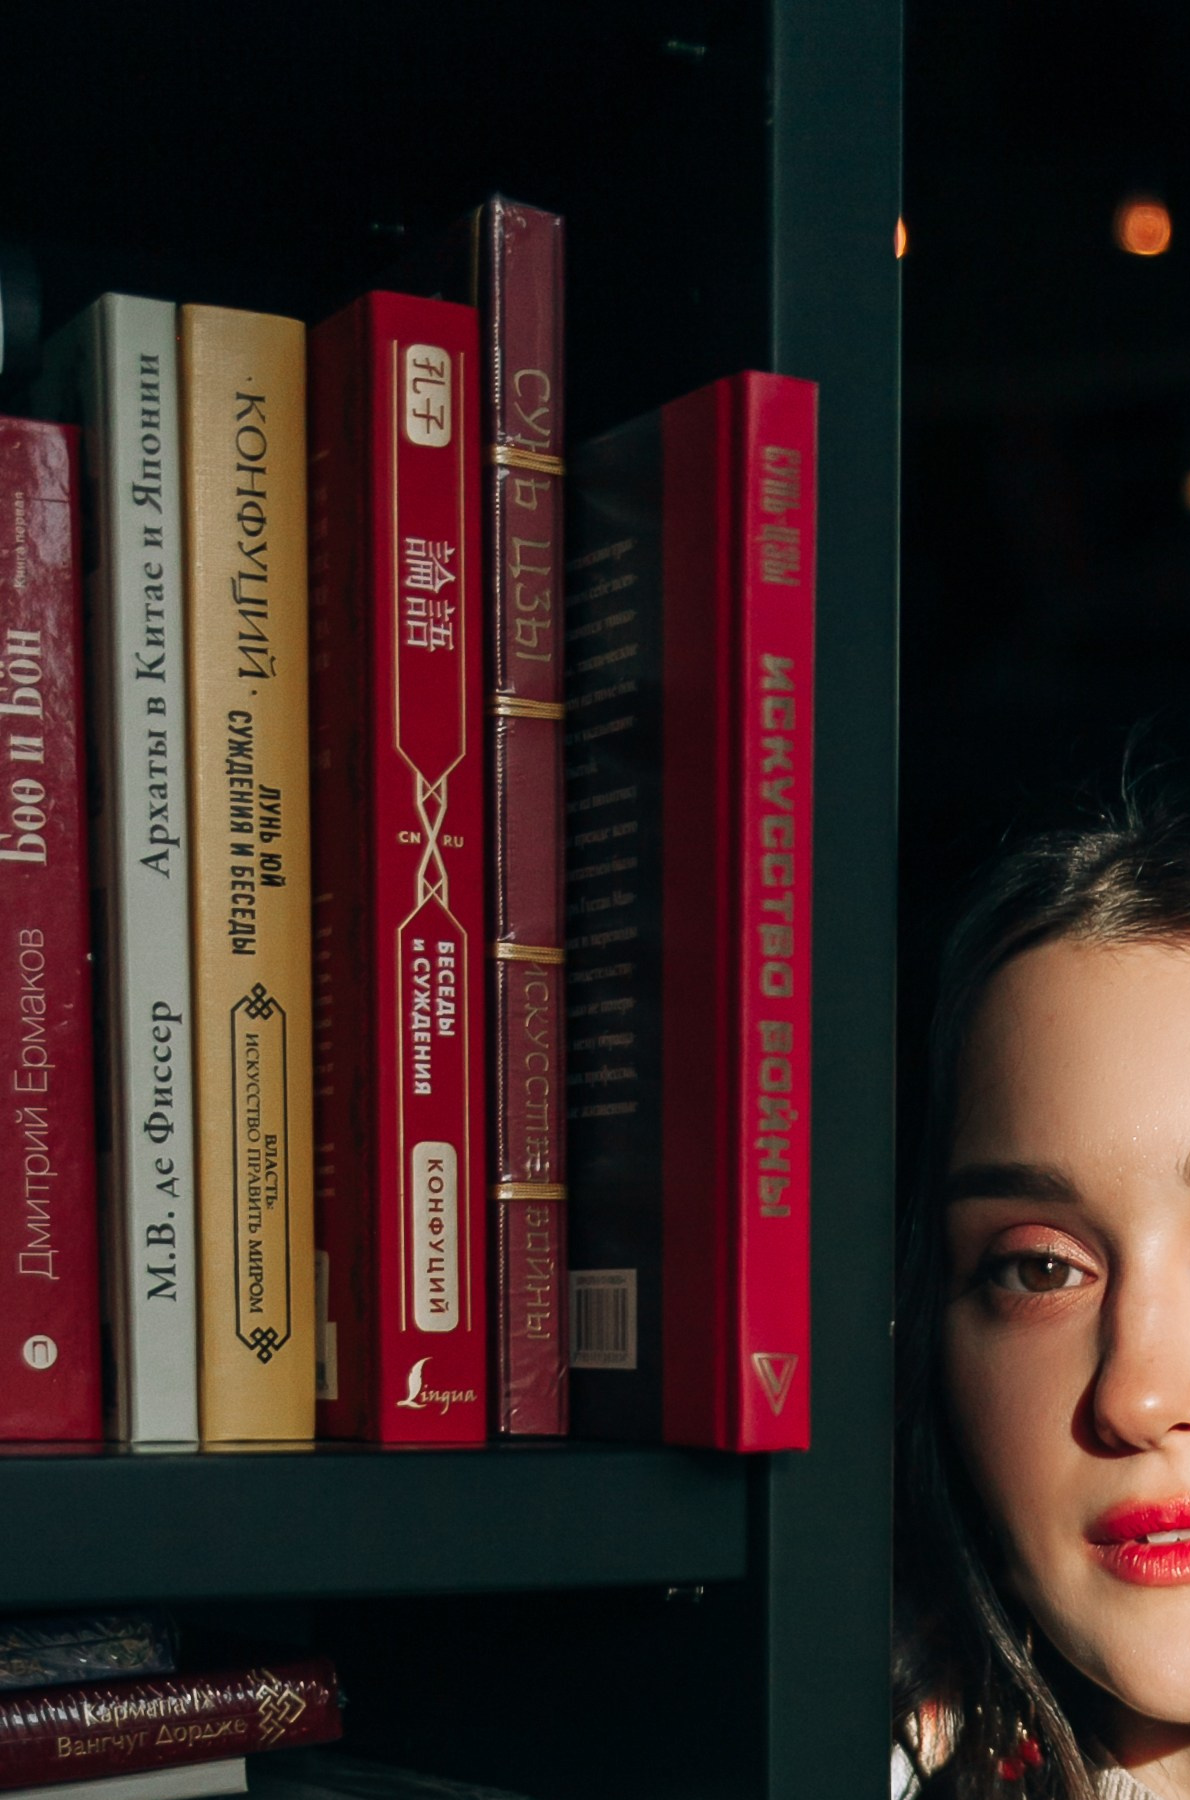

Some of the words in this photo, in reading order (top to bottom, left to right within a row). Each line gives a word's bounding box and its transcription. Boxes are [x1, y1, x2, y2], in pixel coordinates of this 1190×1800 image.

[132, 353, 163, 515] Японии
[411, 355, 445, 435] 孔子
[144, 527, 163, 549] и
[230, 391, 277, 680] КОНФУЦИЙ
[760, 445, 801, 587] СУНЬ-ЦЗЫ
[135, 562, 167, 683] Китае
[404, 537, 455, 653] 論語
[509, 540, 552, 663] ЦЗЫ
[9, 737, 45, 764] и
[148, 696, 166, 717] в
[140, 727, 180, 880] Архаты
[226, 710, 255, 834] СУЖДЕНИЯ
[259, 784, 282, 843] ЛУНЬ
[230, 843, 255, 857] И
[260, 848, 287, 888] ЮЙ
[398, 830, 421, 846] CN
[443, 833, 465, 849] RU
[758, 654, 796, 999] ИСКУССТВО
[227, 864, 257, 956] БЕСЕДЫ
[413, 938, 426, 952] и
[15, 928, 56, 1094] Ермаков
[411, 957, 432, 1095] СУЖДЕНИЯ
[436, 941, 456, 1037] БЕСЕДЫ
[145, 1001, 184, 1146] Фиссер
[244, 1033, 262, 1143] ИСКУССТВО
[755, 1020, 798, 1218] ВОЙНЫ
[15, 1107, 60, 1281] Дмитрий
[153, 1157, 181, 1199] де
[247, 1148, 263, 1234] ПРАВИТЬ
[264, 1133, 280, 1210] ВЛАСТЬ:
[146, 1211, 177, 1303] М.В.
[248, 1240, 264, 1314] МИРОМ
[428, 1159, 452, 1314] КОНФУЦИЙ
[522, 1205, 552, 1340] ВОЙНЫ
[56, 1730, 149, 1758] Вангчуг
[155, 1717, 248, 1747] Дордже
